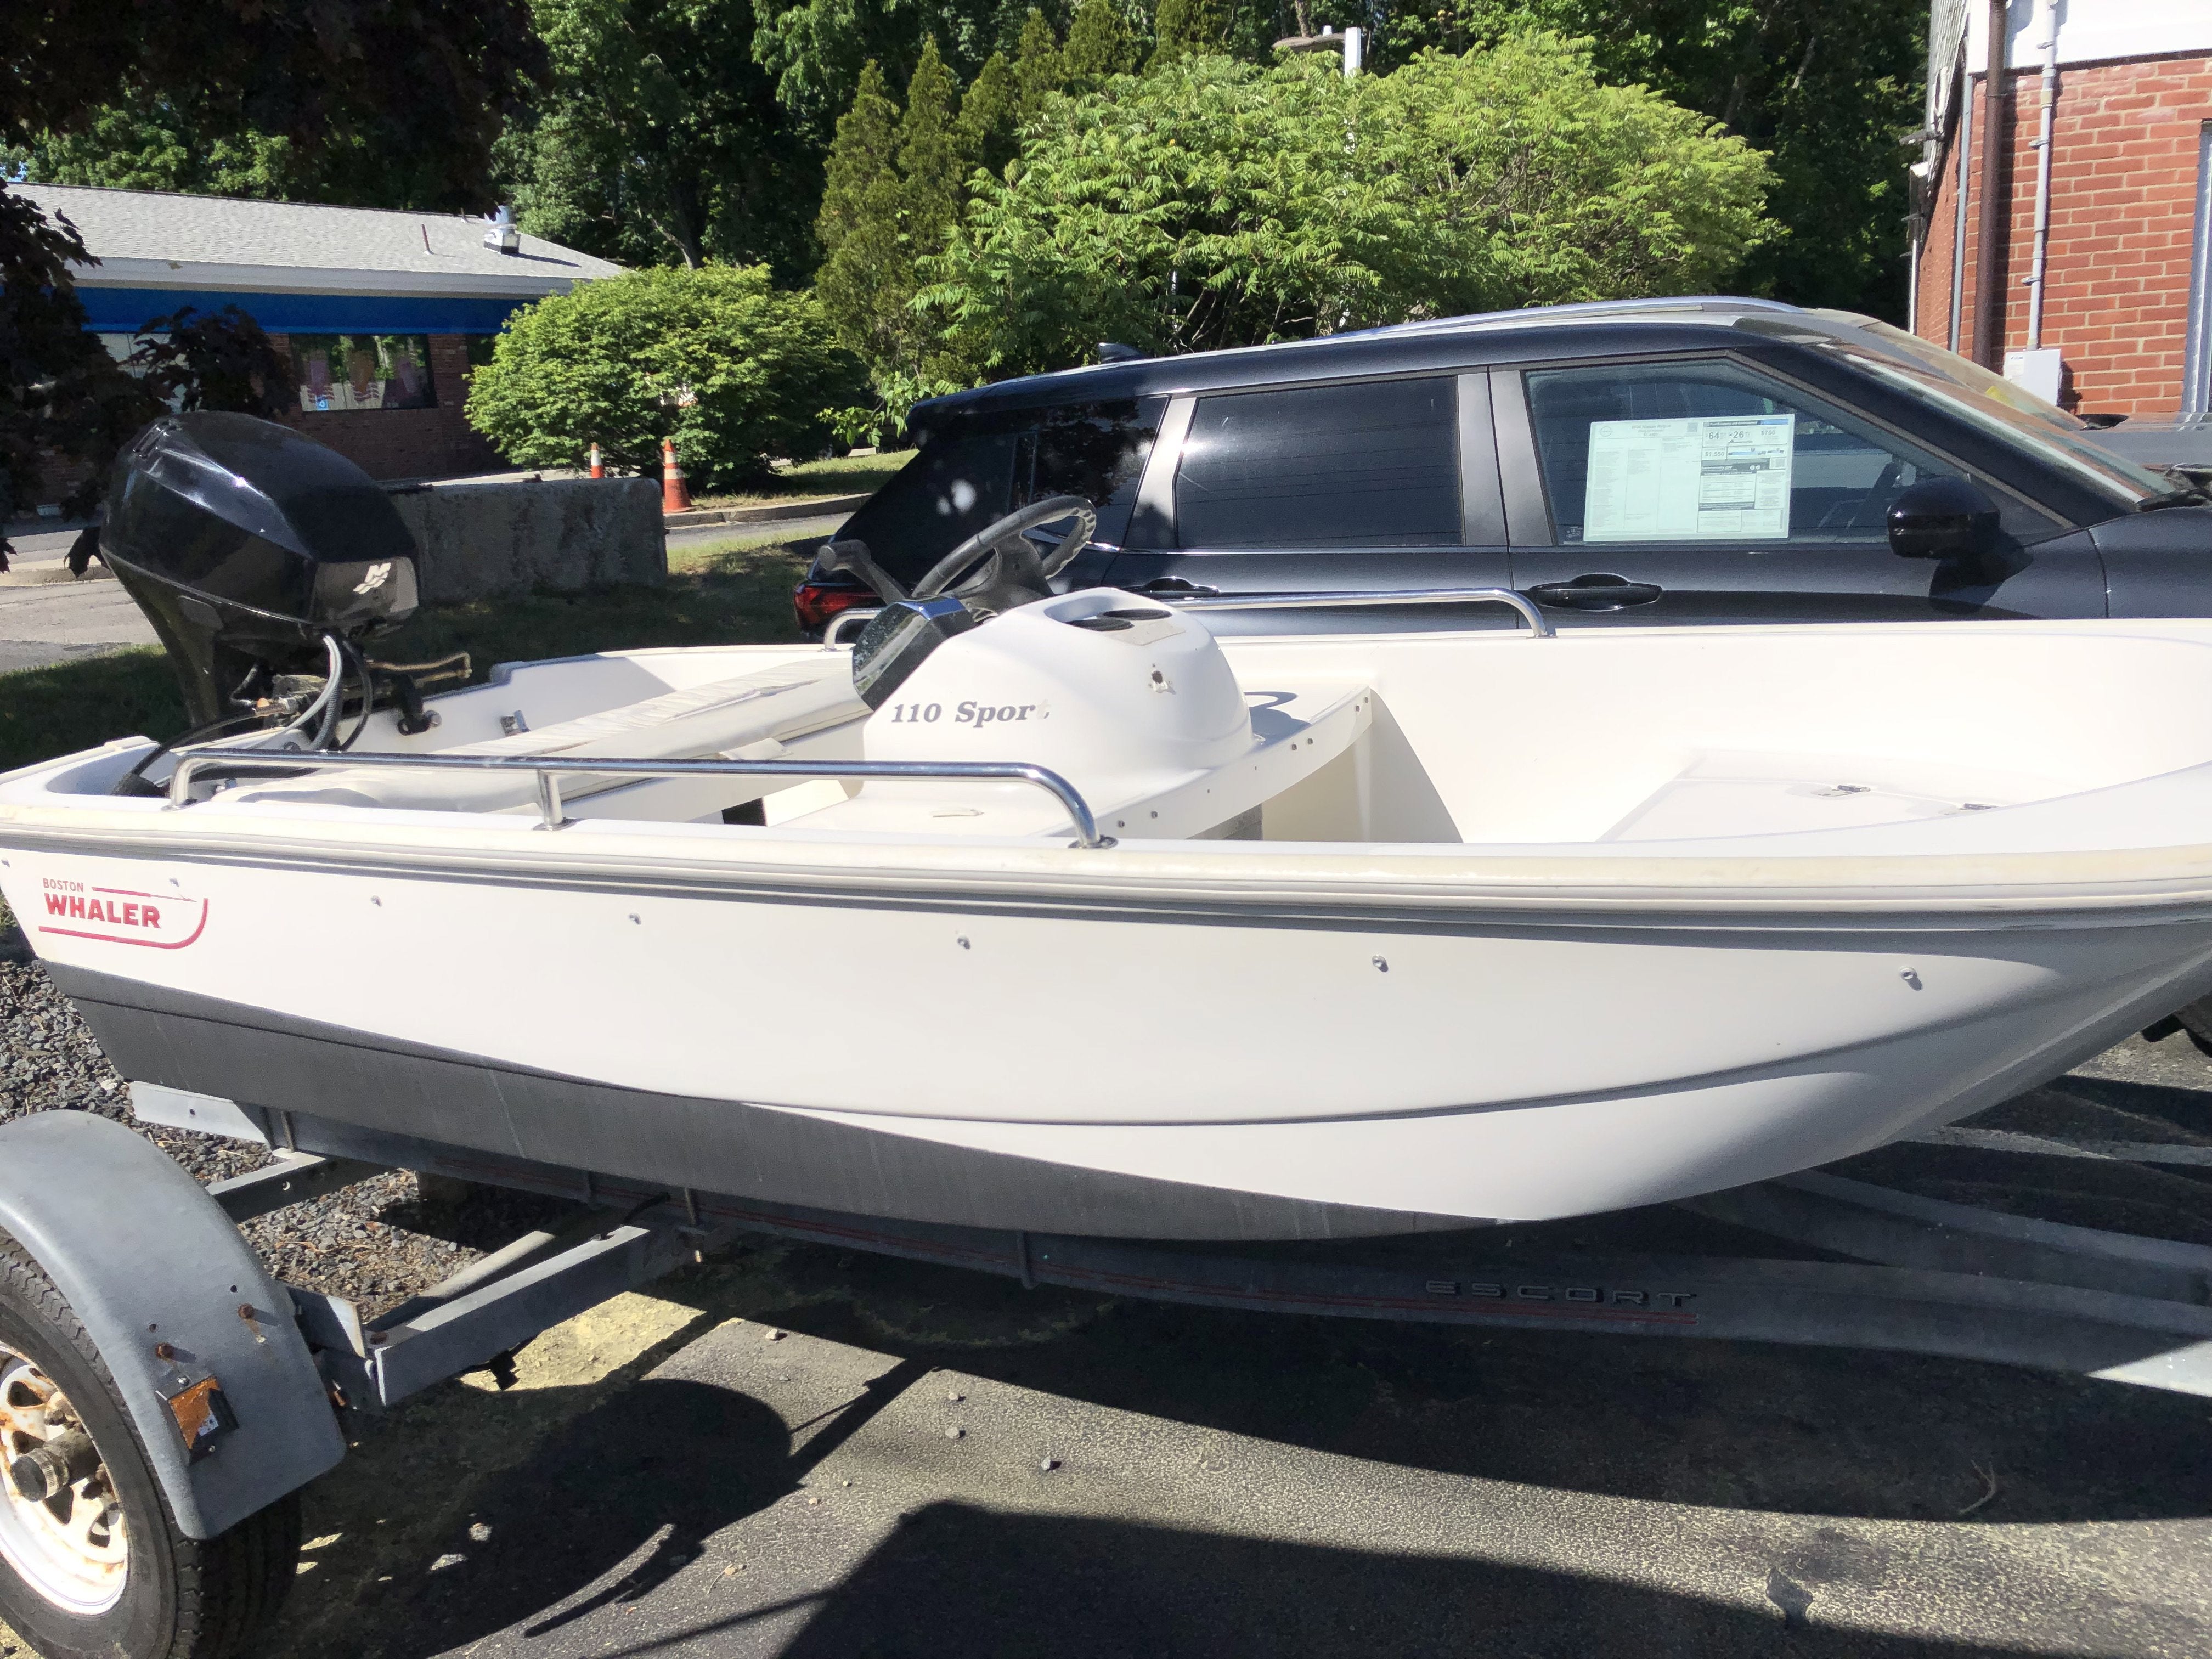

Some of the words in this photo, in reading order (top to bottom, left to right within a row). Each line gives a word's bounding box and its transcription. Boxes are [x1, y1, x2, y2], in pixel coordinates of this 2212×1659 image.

[891, 703, 942, 723] 110
[43, 878, 84, 893] BOSTON
[44, 893, 161, 929] WHALER
[1426, 1280, 1693, 1307] ESCORT
